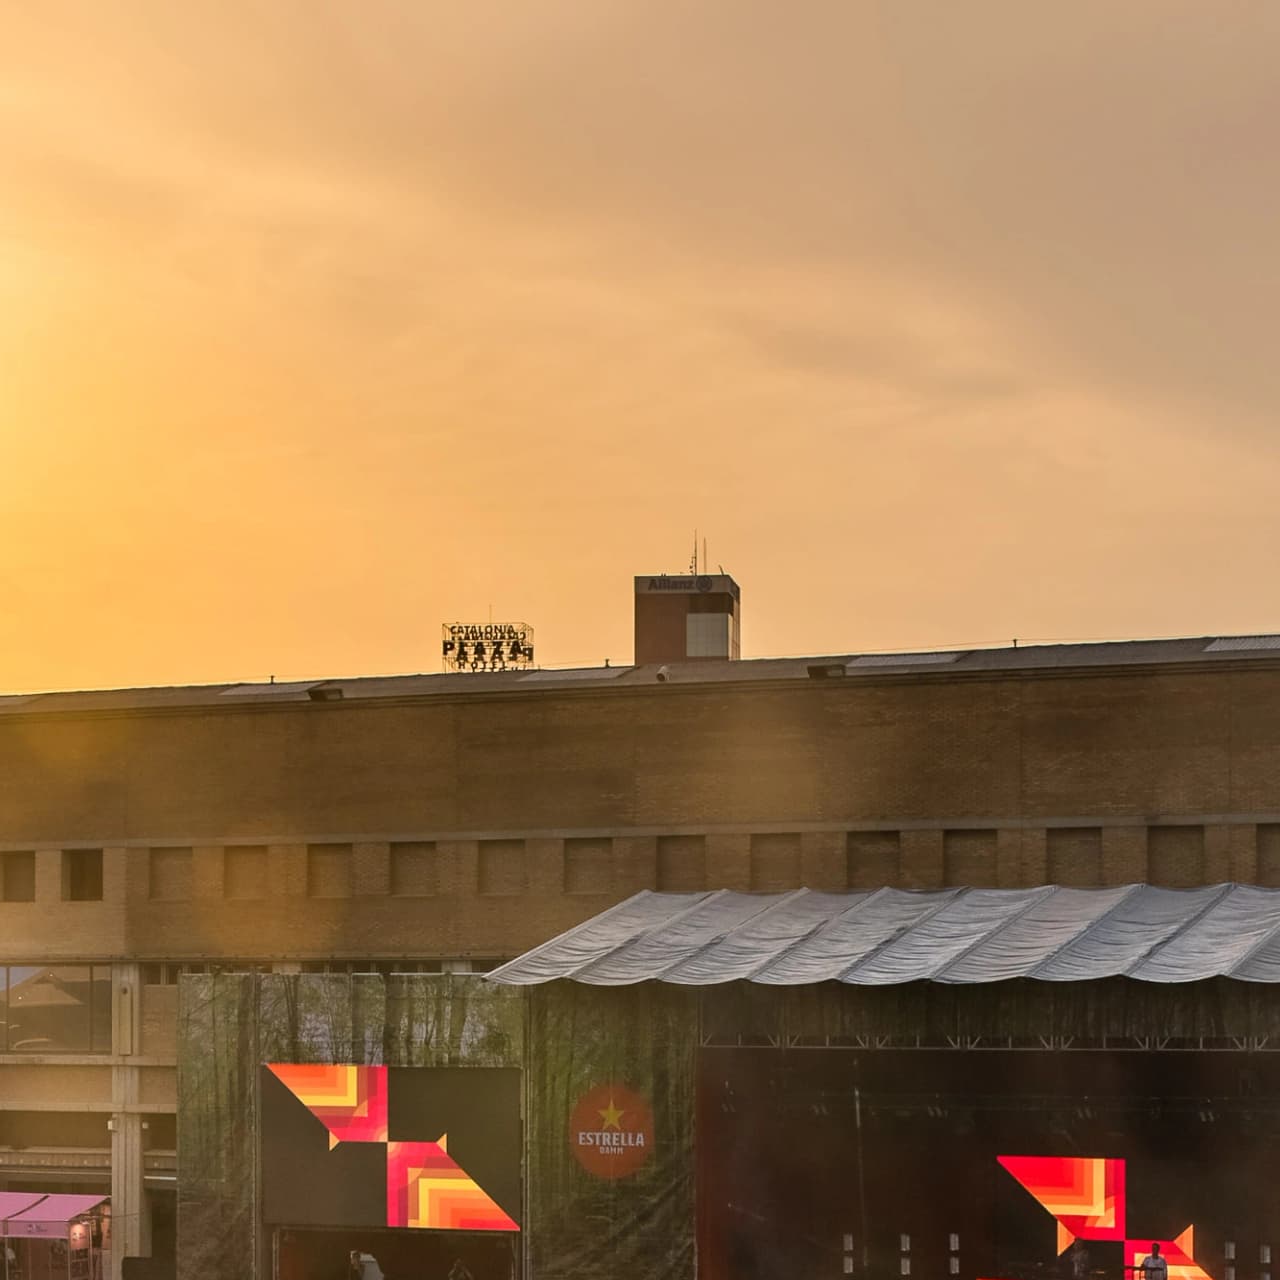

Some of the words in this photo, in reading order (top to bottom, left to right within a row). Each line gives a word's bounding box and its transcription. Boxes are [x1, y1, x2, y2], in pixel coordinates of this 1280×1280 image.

[450, 625, 515, 634] CATALONIA
[578, 1132, 645, 1147] ESTRELLA
[599, 1146, 624, 1155] DAMM
